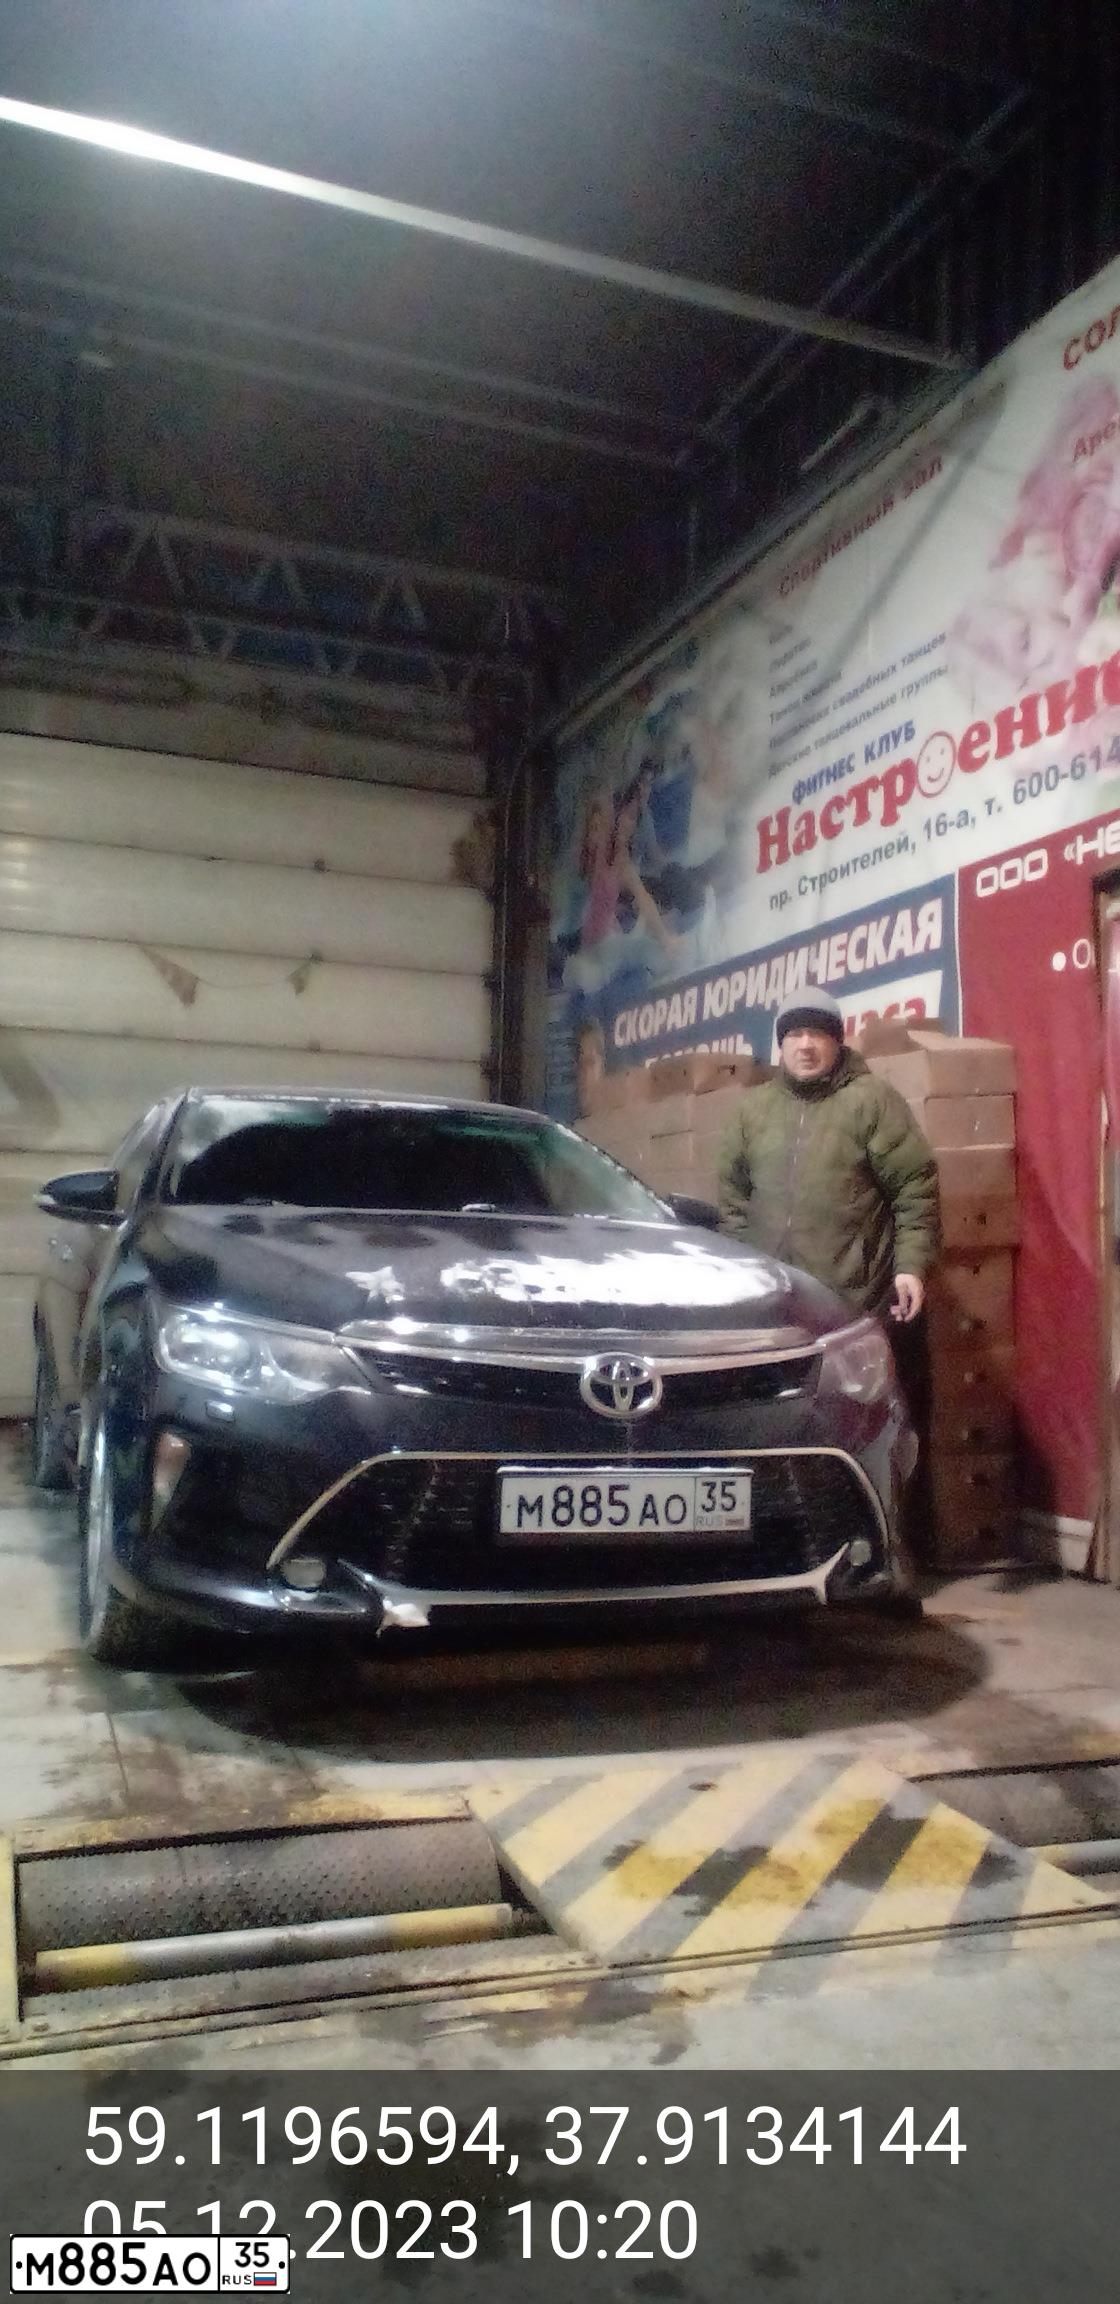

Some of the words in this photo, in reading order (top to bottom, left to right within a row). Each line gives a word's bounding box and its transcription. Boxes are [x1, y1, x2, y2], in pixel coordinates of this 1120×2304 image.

[899, 665, 949, 700] группы
[792, 752, 856, 805] ФИТНЕС
[864, 719, 917, 765] КЛУБ
[769, 889, 793, 911] пр.
[798, 832, 917, 897] Строителей,
[922, 808, 977, 842] 16-а,
[985, 796, 1004, 816] т.
[1013, 732, 1120, 806] 600-614
[976, 848, 1049, 899] ООО
[613, 986, 699, 1048] СКОРАЯ
[703, 898, 943, 1020] ЮРИДИЧЕСКАЯ
[516, 1484, 687, 1528] М885АО
[701, 1481, 737, 1513] 35
